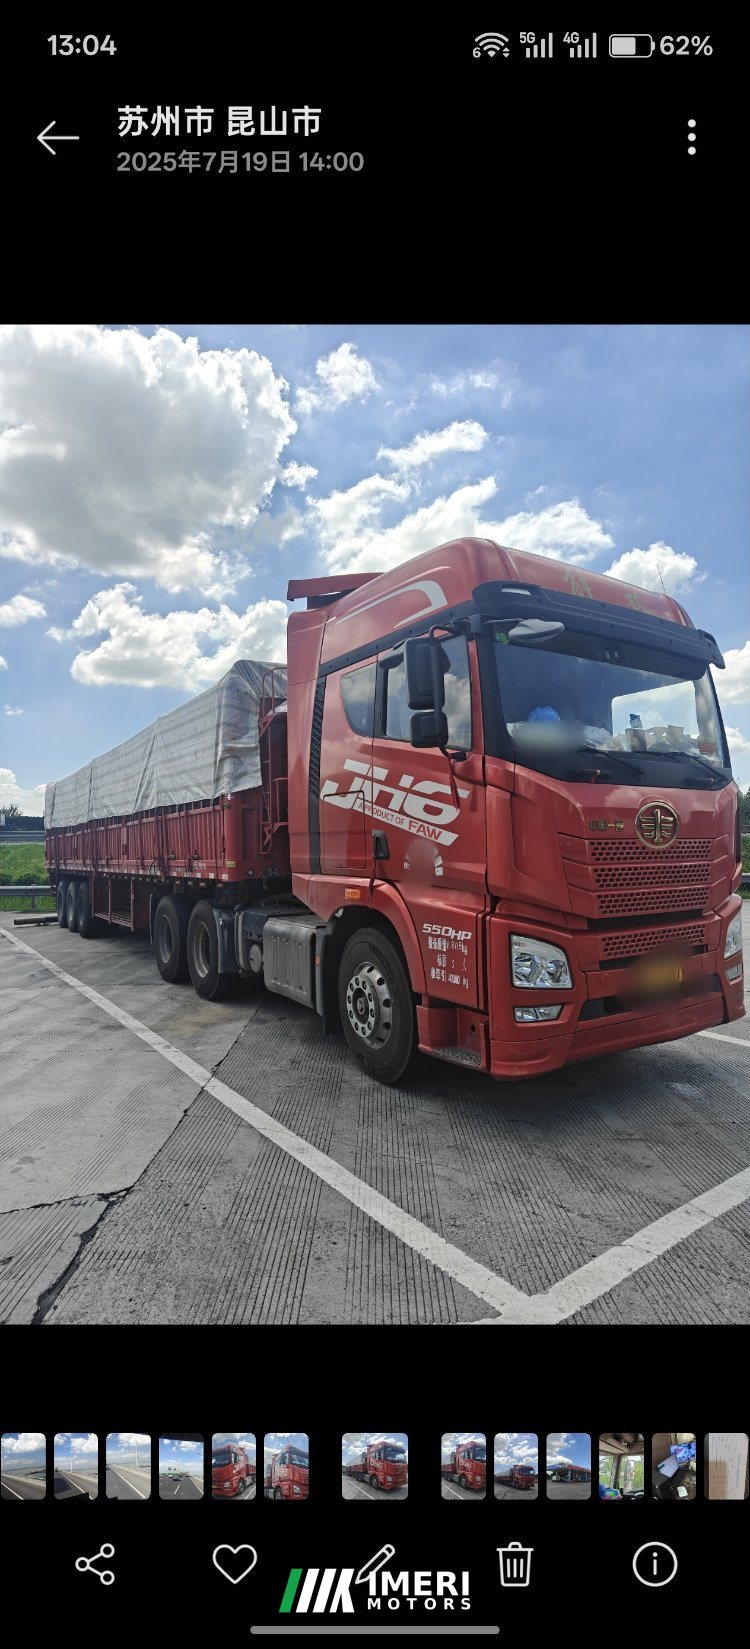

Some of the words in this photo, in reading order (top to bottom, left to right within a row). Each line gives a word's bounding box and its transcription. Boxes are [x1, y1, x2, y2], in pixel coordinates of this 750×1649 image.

[47, 35, 117, 56] 13:04
[519, 32, 536, 44] 5G
[562, 32, 580, 44] 4G
[660, 36, 713, 56] 62%
[117, 105, 215, 137] 苏州市
[228, 105, 322, 137] 昆山市
[117, 150, 290, 174] 2025年7月19日
[299, 151, 364, 171] 14:00
[319, 758, 472, 825] JH6
[395, 817, 405, 826] OF
[408, 819, 442, 841] FAW
[422, 923, 472, 940] 550HP
